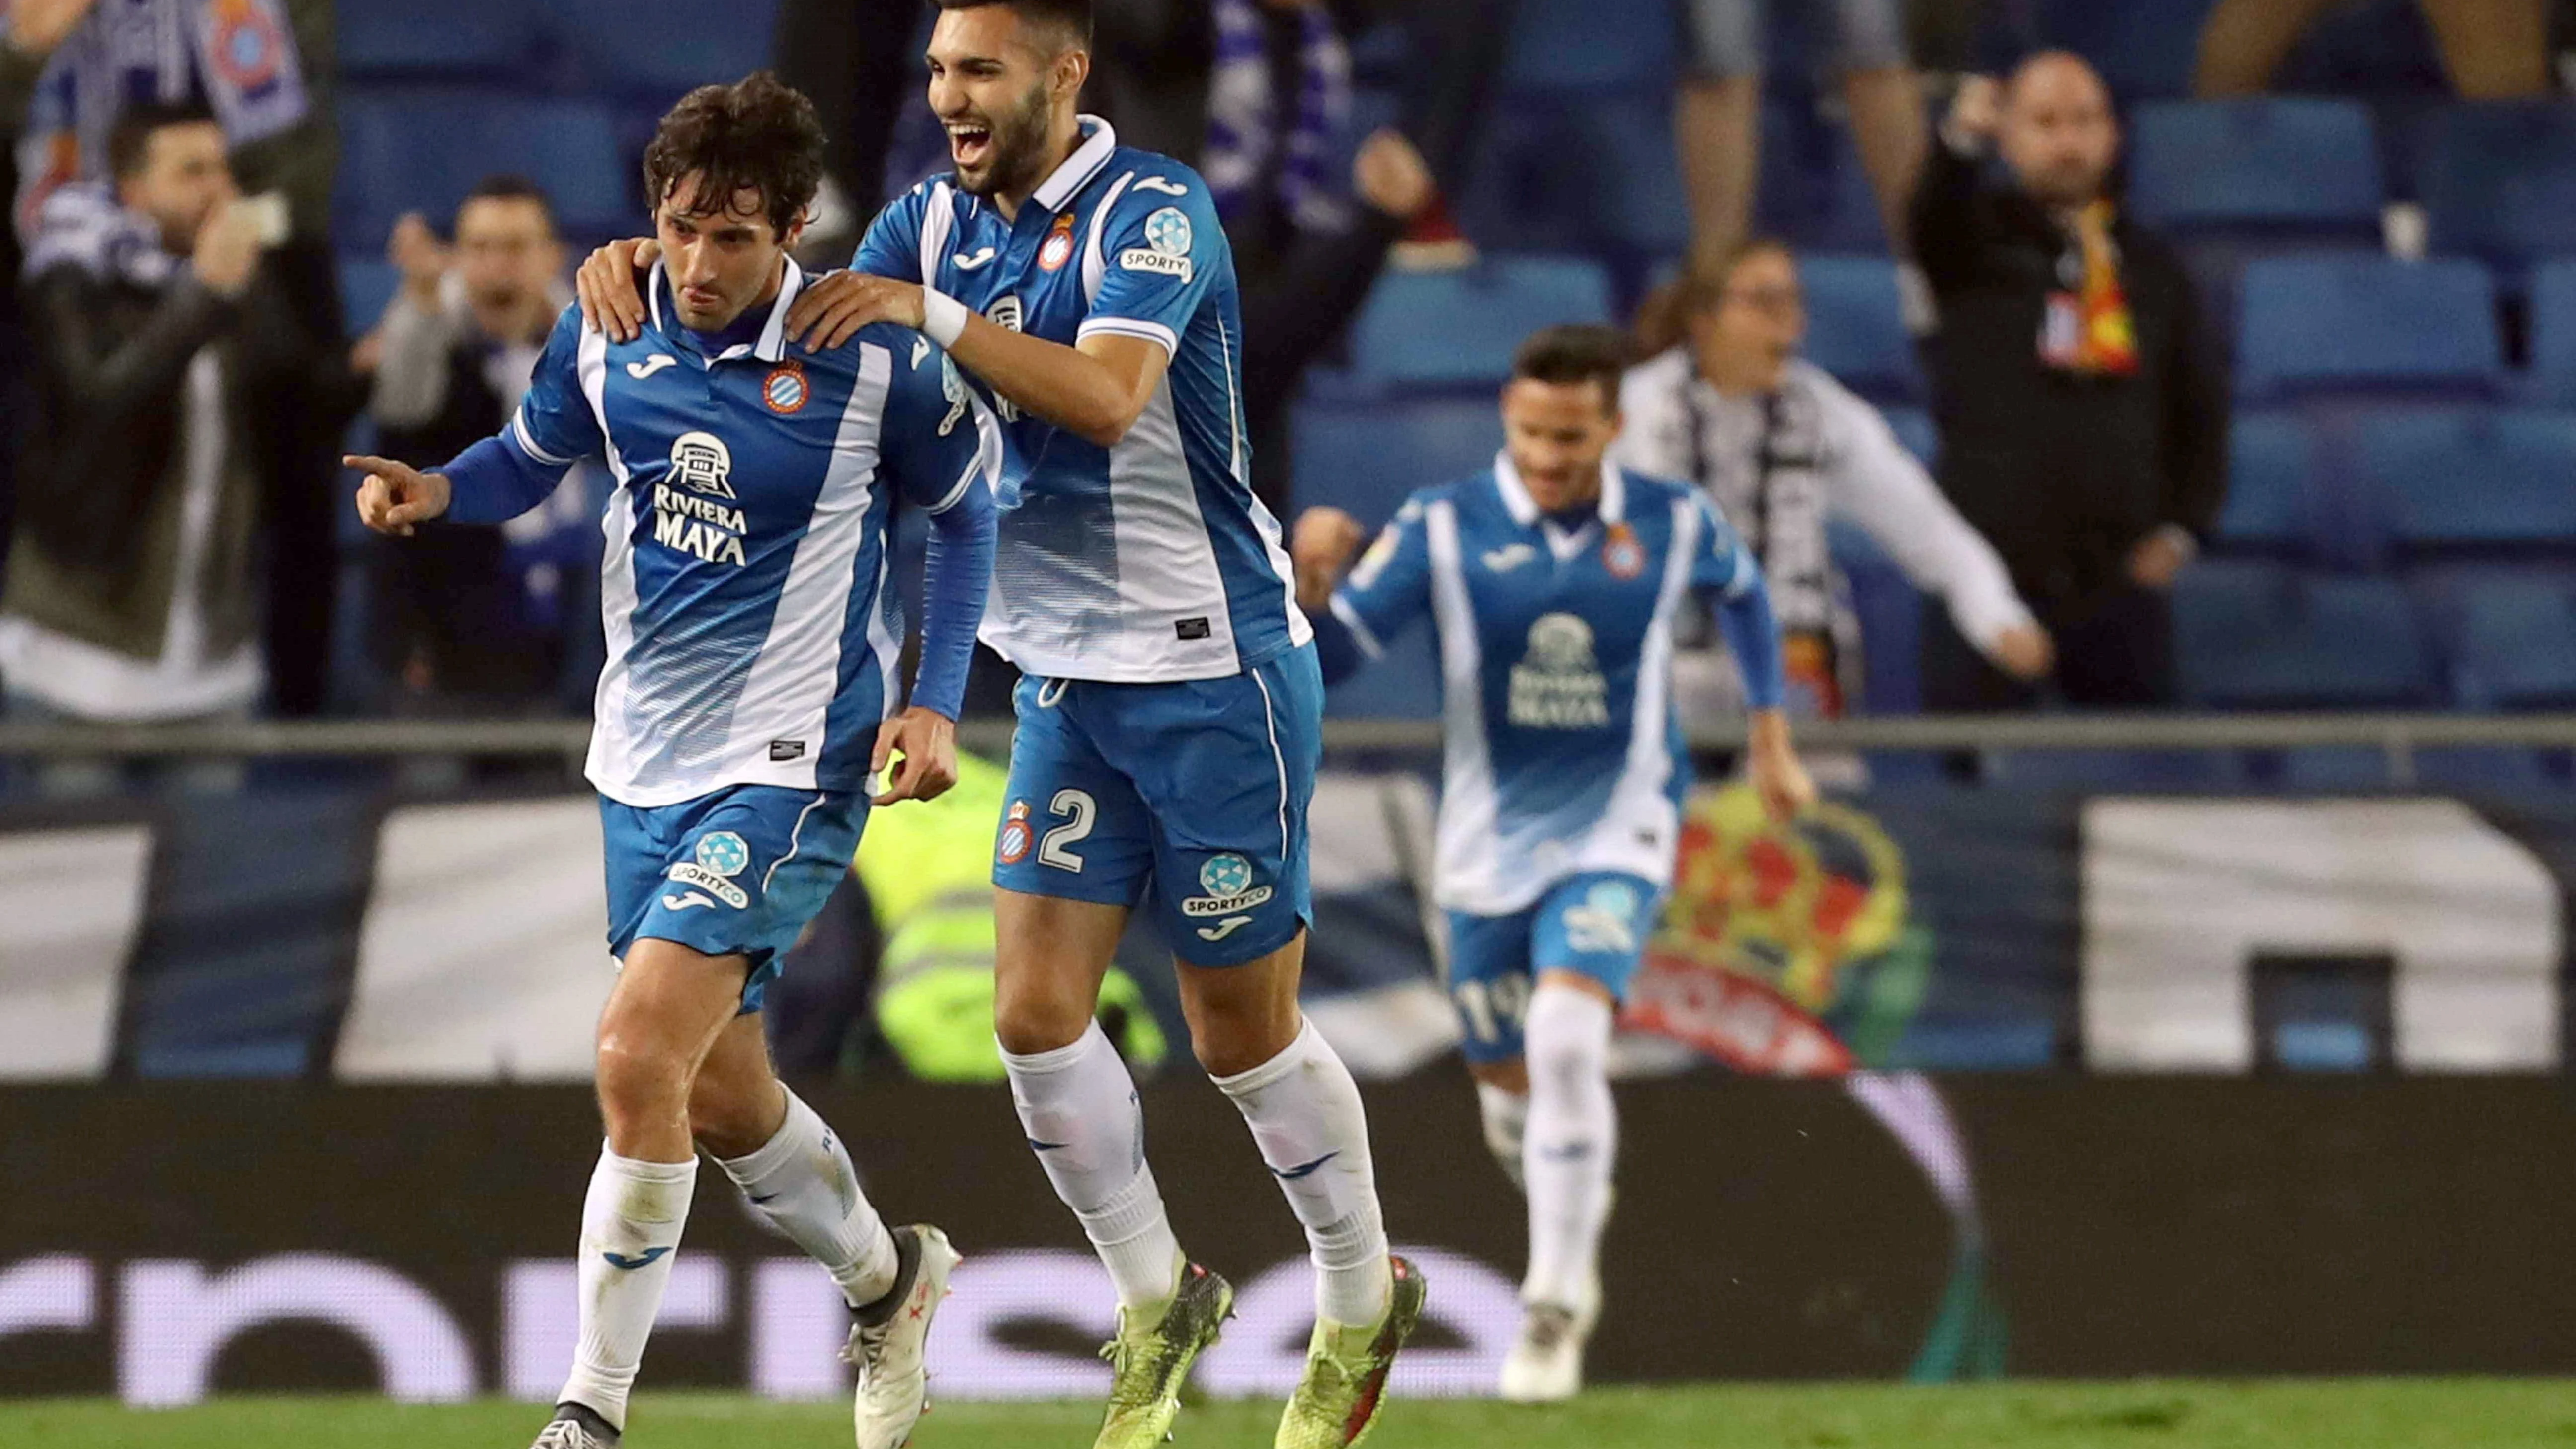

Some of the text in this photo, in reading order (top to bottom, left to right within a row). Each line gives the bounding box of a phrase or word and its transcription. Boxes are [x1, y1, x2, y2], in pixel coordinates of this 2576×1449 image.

[654, 483, 747, 535] RIVIERA
[654, 509, 746, 567] MAYA
[1038, 789, 1096, 873] 2
[673, 867, 743, 903] SPORTYCO
[1188, 888, 1267, 912] SPORTYCO
